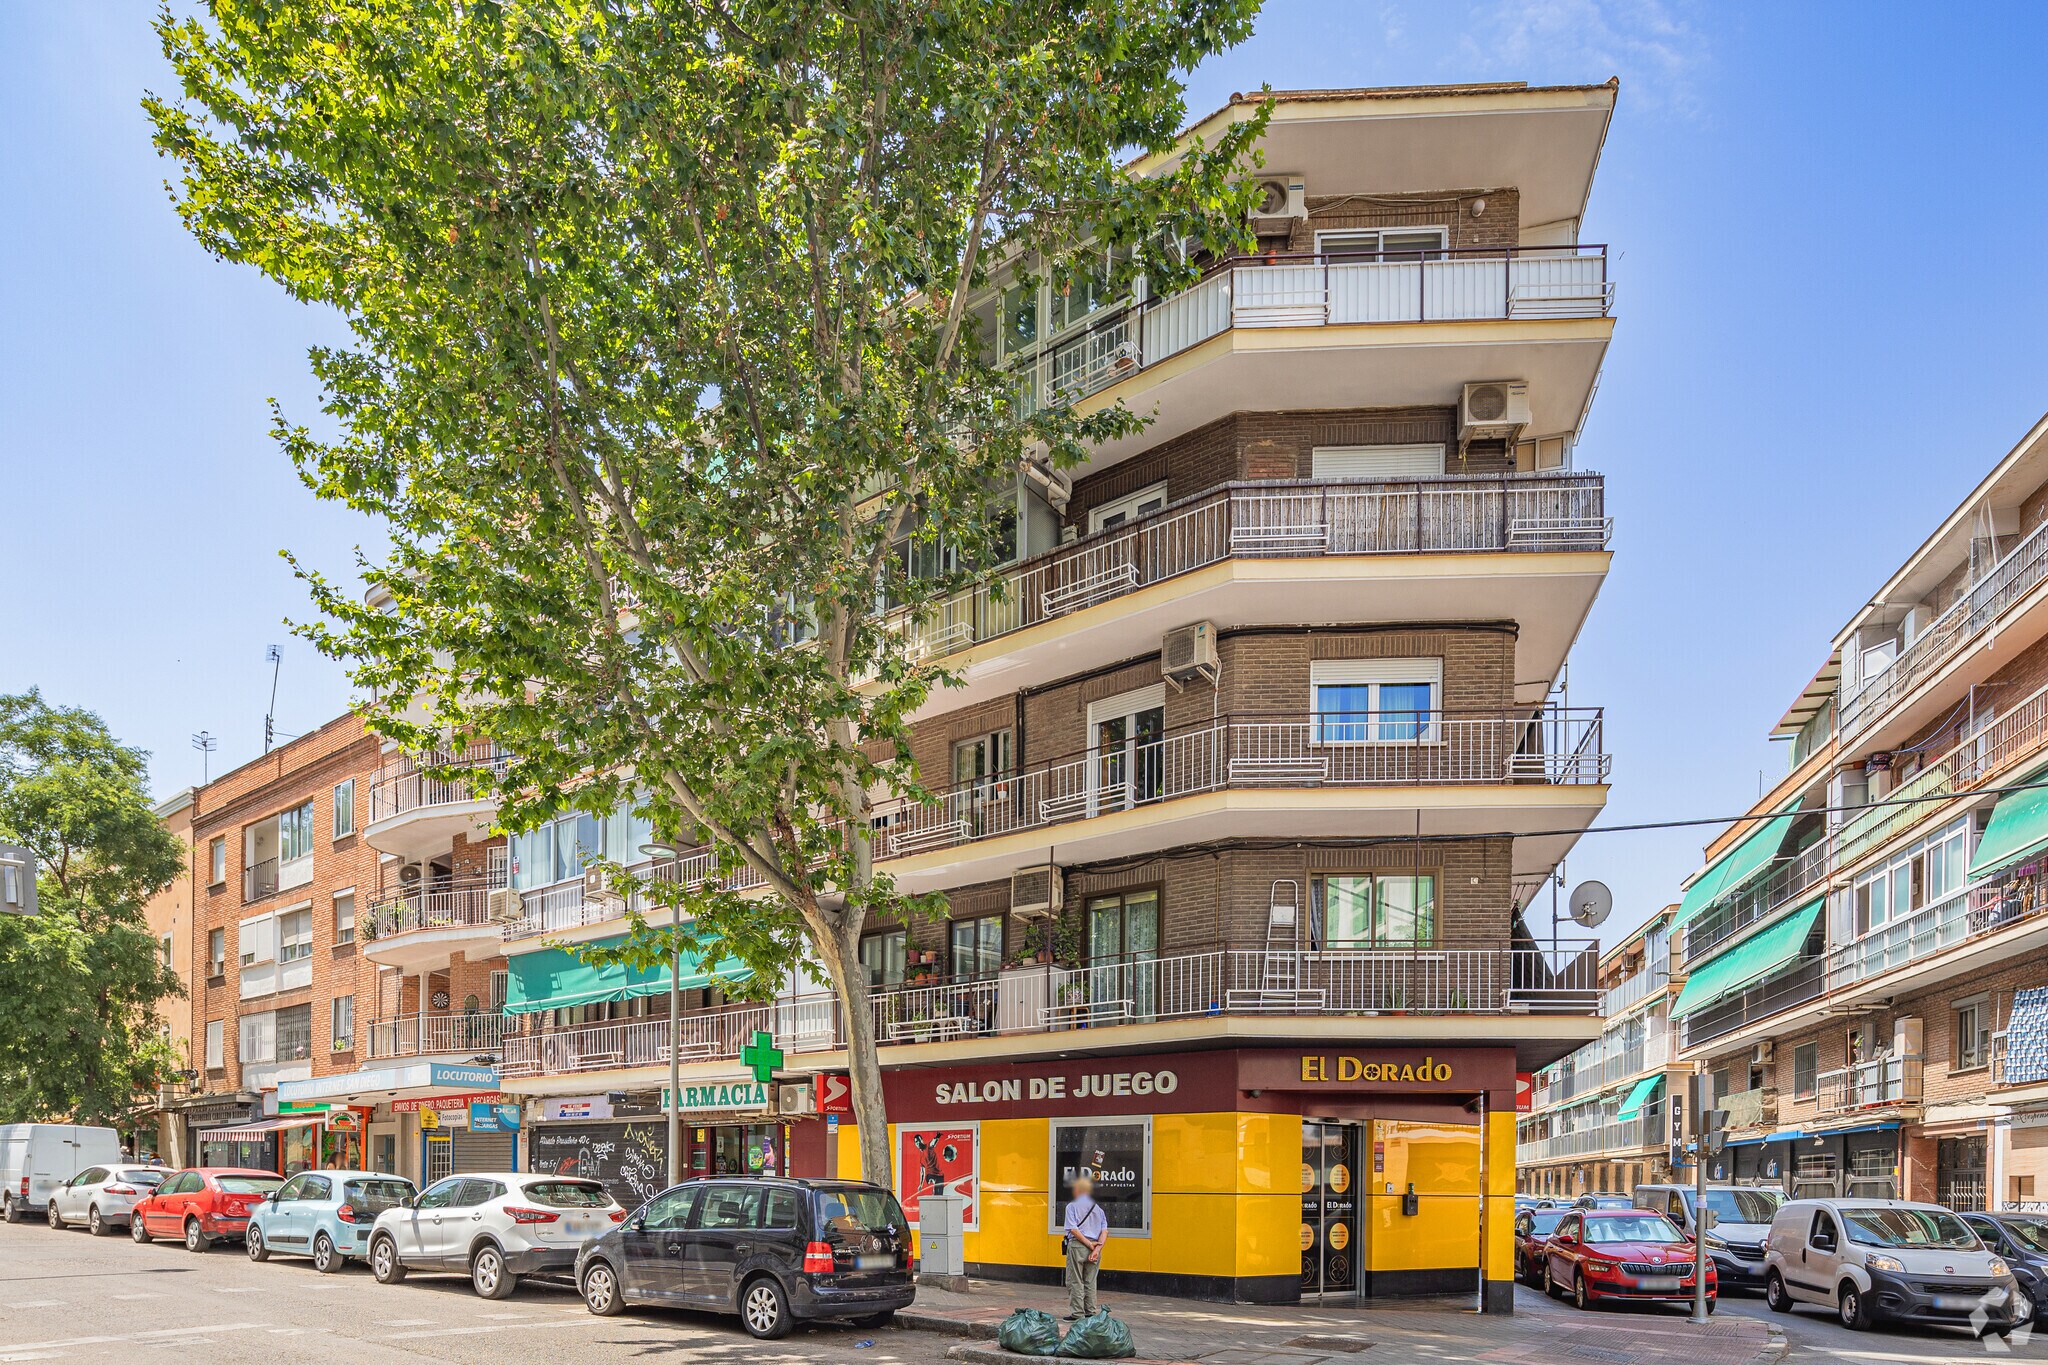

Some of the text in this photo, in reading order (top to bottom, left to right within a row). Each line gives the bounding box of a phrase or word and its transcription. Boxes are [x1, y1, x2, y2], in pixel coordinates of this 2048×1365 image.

[437, 1070, 493, 1083] LOCUTORIO
[935, 1070, 1178, 1105] SALON DE JUEGO
[436, 1098, 465, 1109] PAQUETERIA
[1673, 1106, 1681, 1147] GYM
